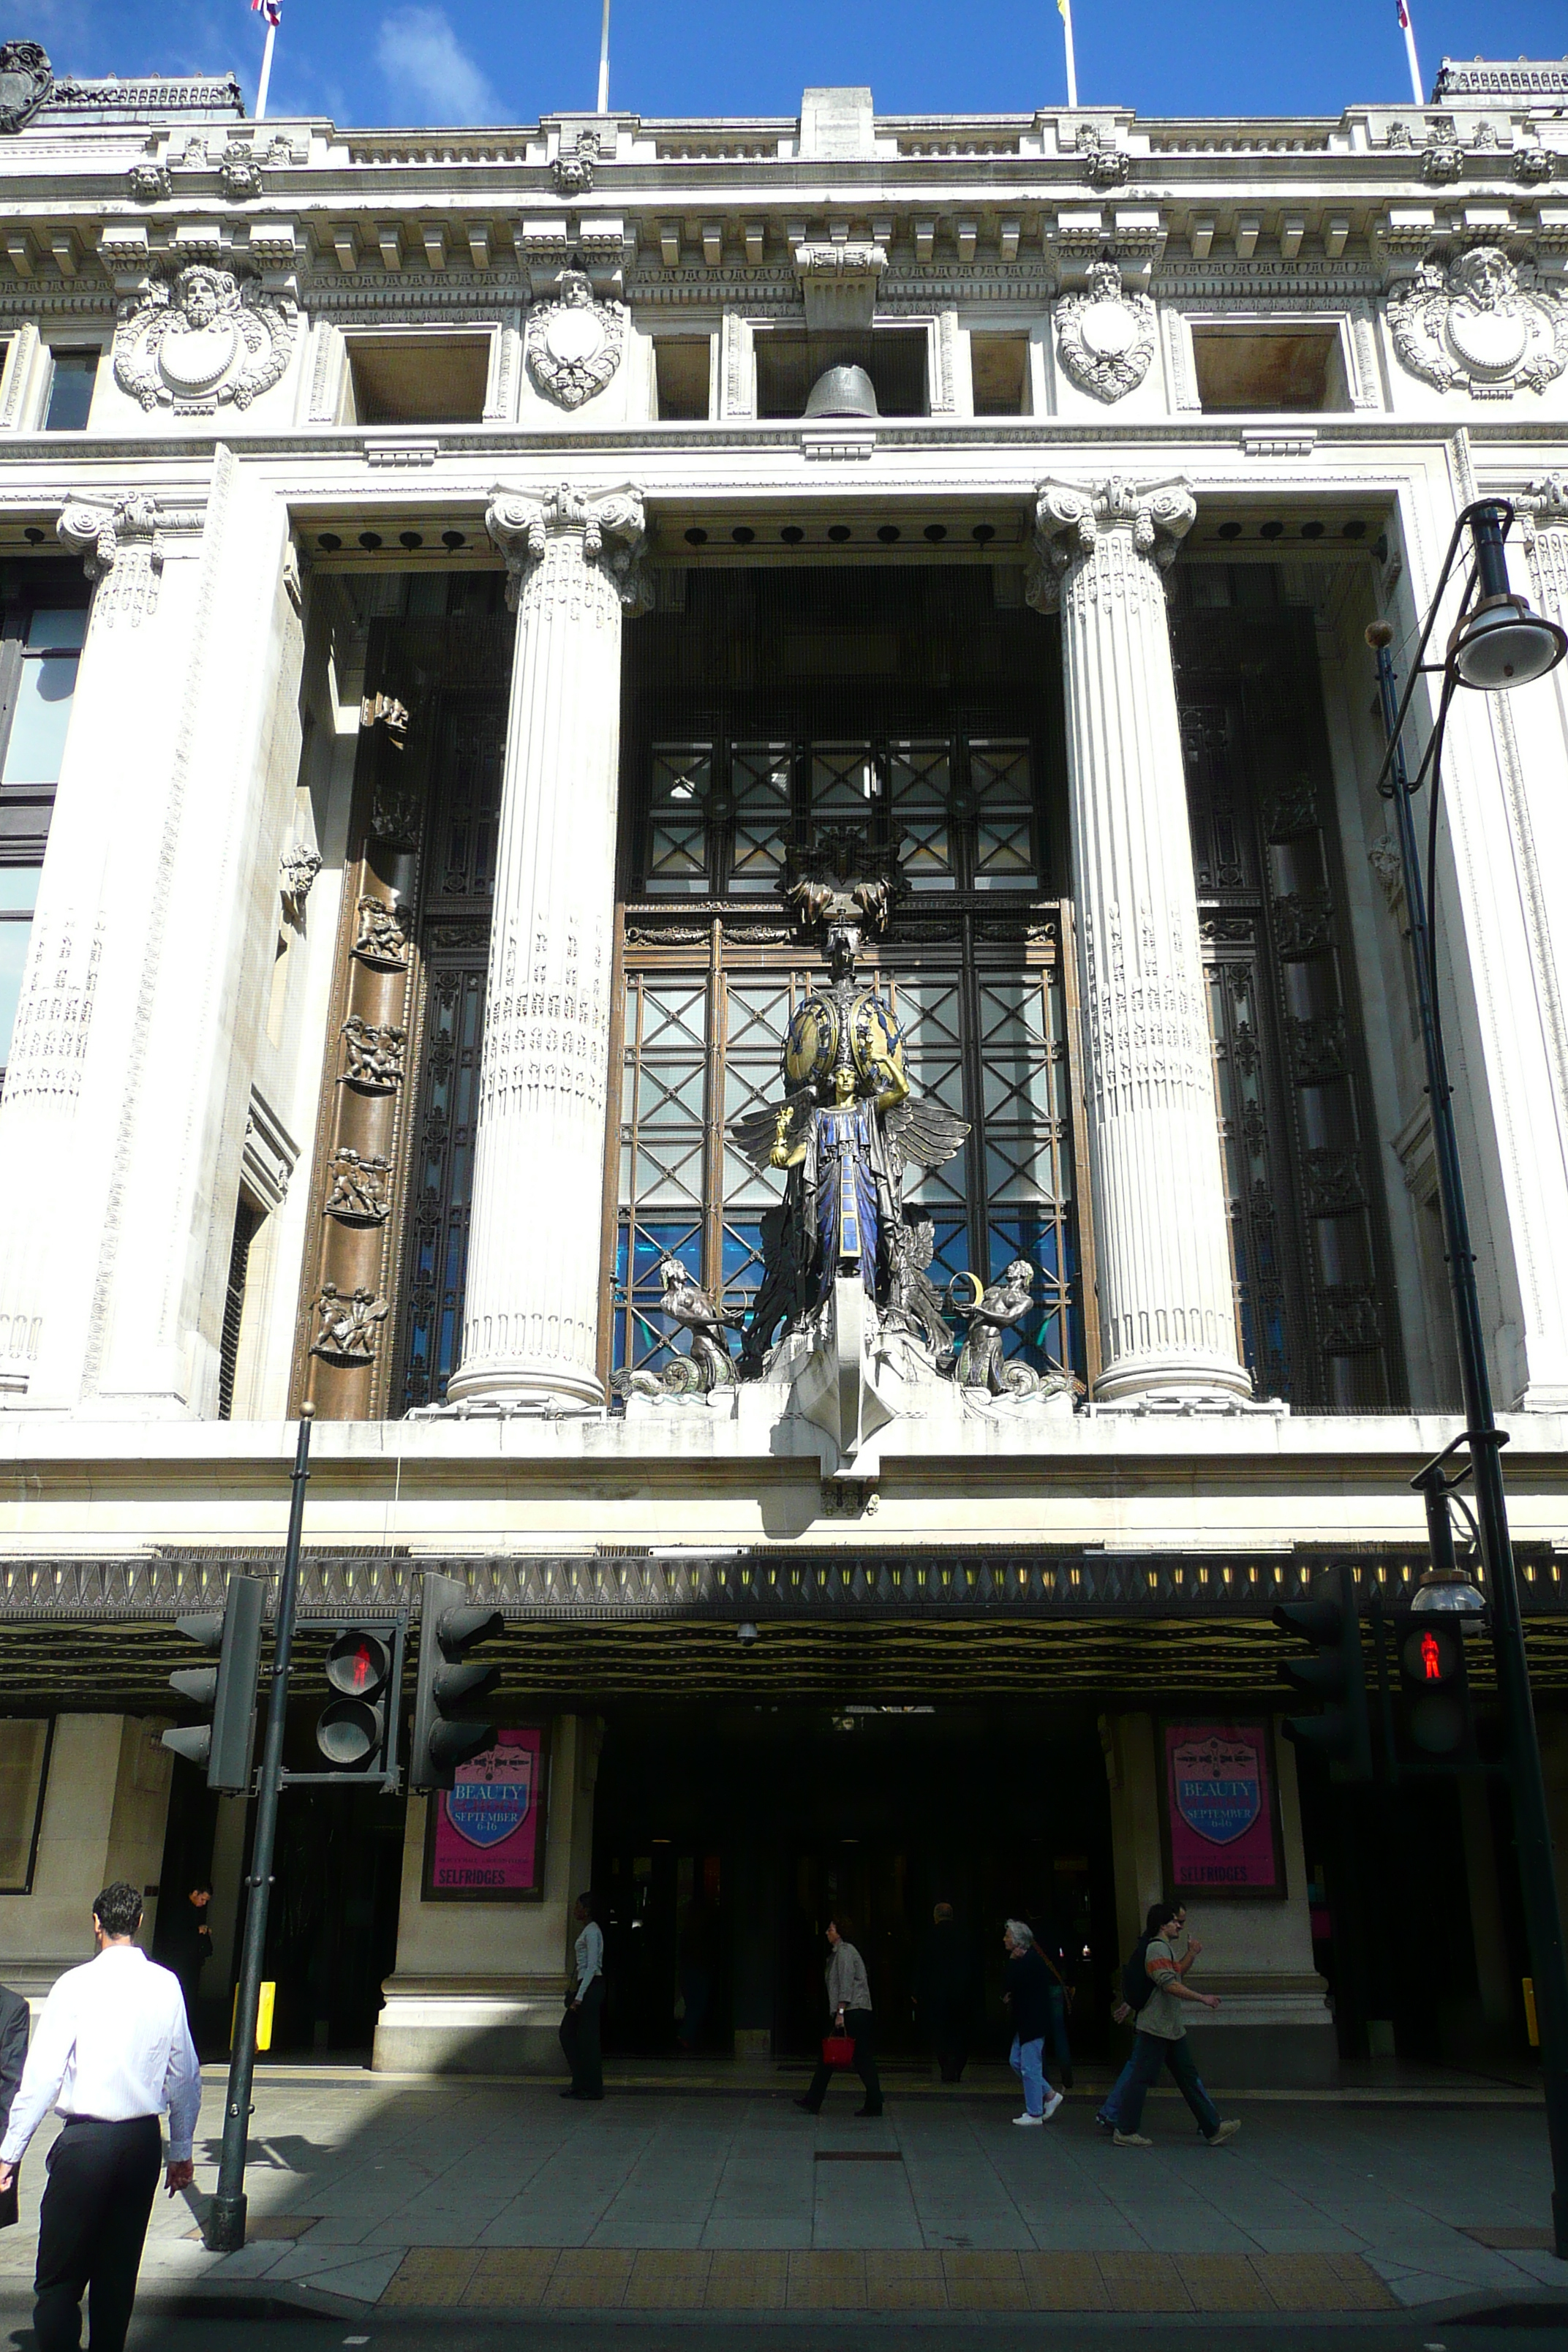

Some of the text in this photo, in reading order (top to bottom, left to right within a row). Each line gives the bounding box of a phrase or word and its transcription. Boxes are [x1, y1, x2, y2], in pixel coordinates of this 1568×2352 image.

[455, 1785, 522, 1800] BEAUTY
[1185, 1782, 1251, 1796] BEAUTY
[453, 1799, 524, 1812] SCHOOL
[454, 1812, 518, 1822] SEPTEMBER
[1187, 1809, 1251, 1819] SEPTEMBER
[476, 1822, 497, 1831] 6-16
[439, 1869, 505, 1885] SELFRIDGES
[1180, 1866, 1248, 1882] SELFRIDGES
